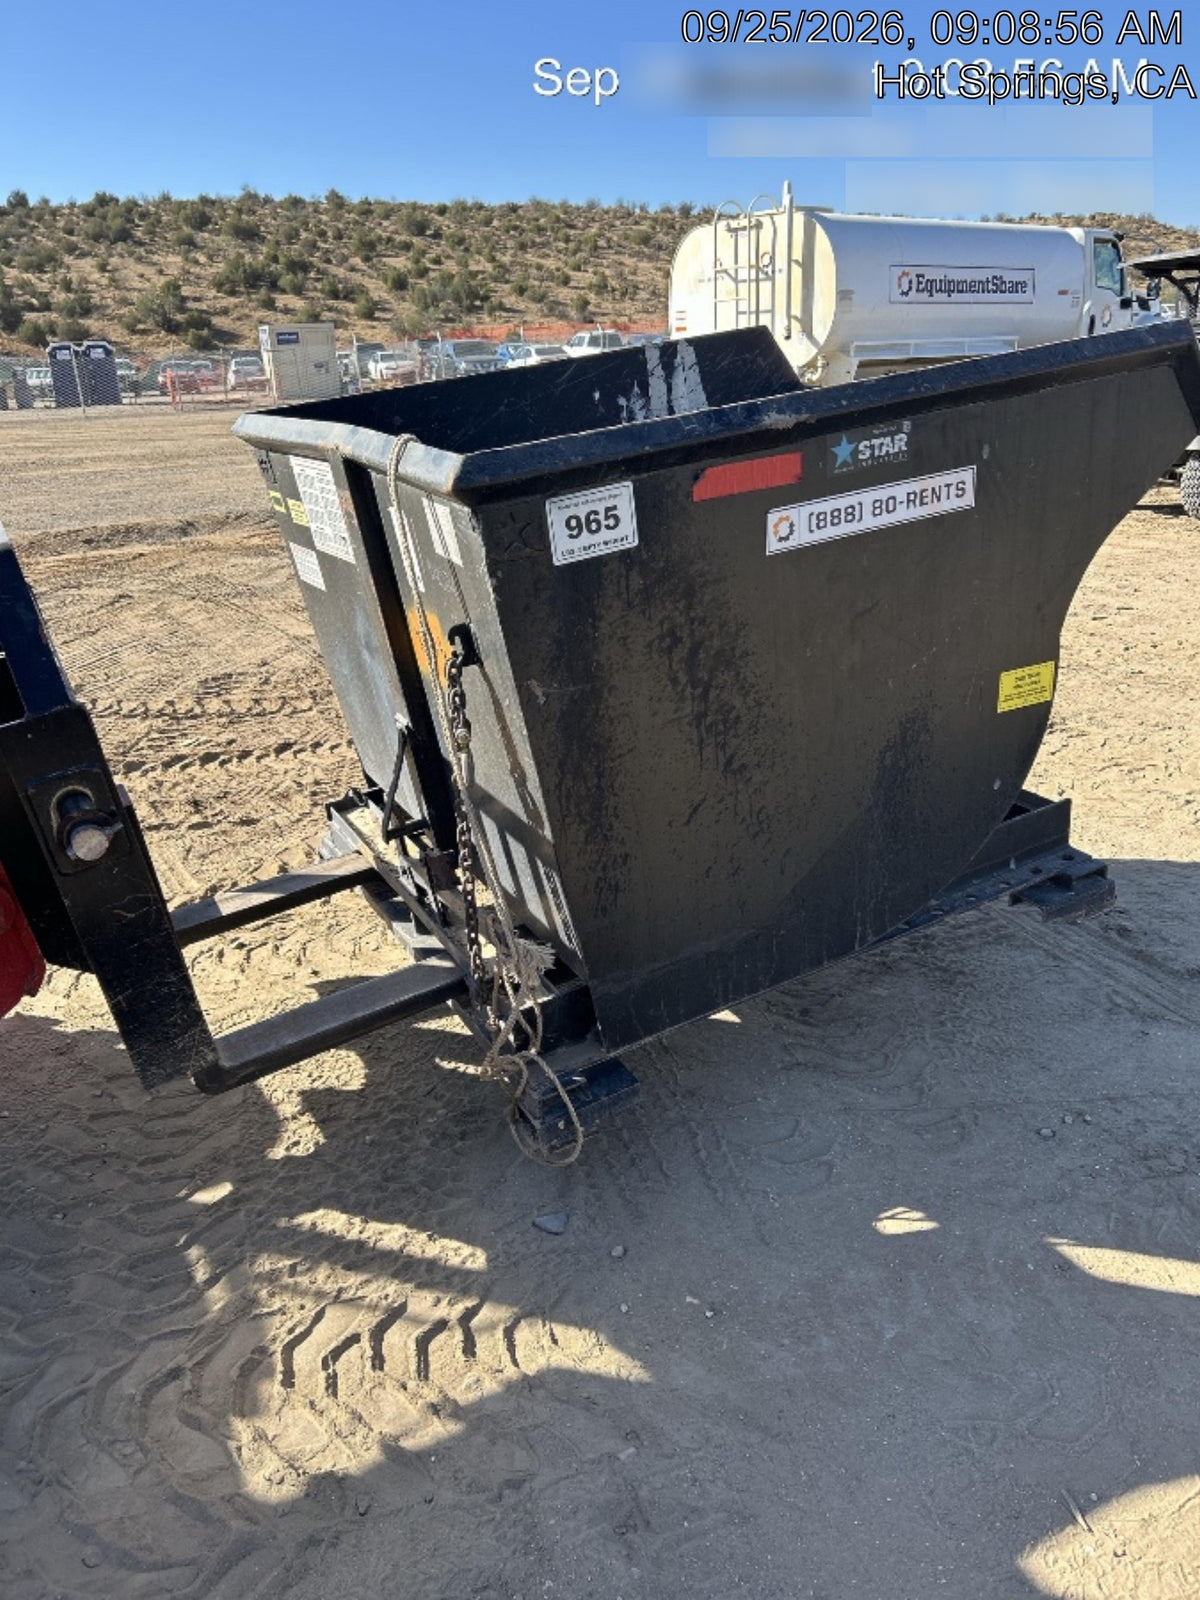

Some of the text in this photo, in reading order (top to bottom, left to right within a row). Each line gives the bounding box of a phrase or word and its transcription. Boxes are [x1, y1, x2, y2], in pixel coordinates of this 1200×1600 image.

[915, 273, 1029, 298] EquipmentShare
[858, 432, 908, 460] STAR
[564, 504, 622, 540] 965
[807, 480, 967, 534] (888) 80-RENTS
